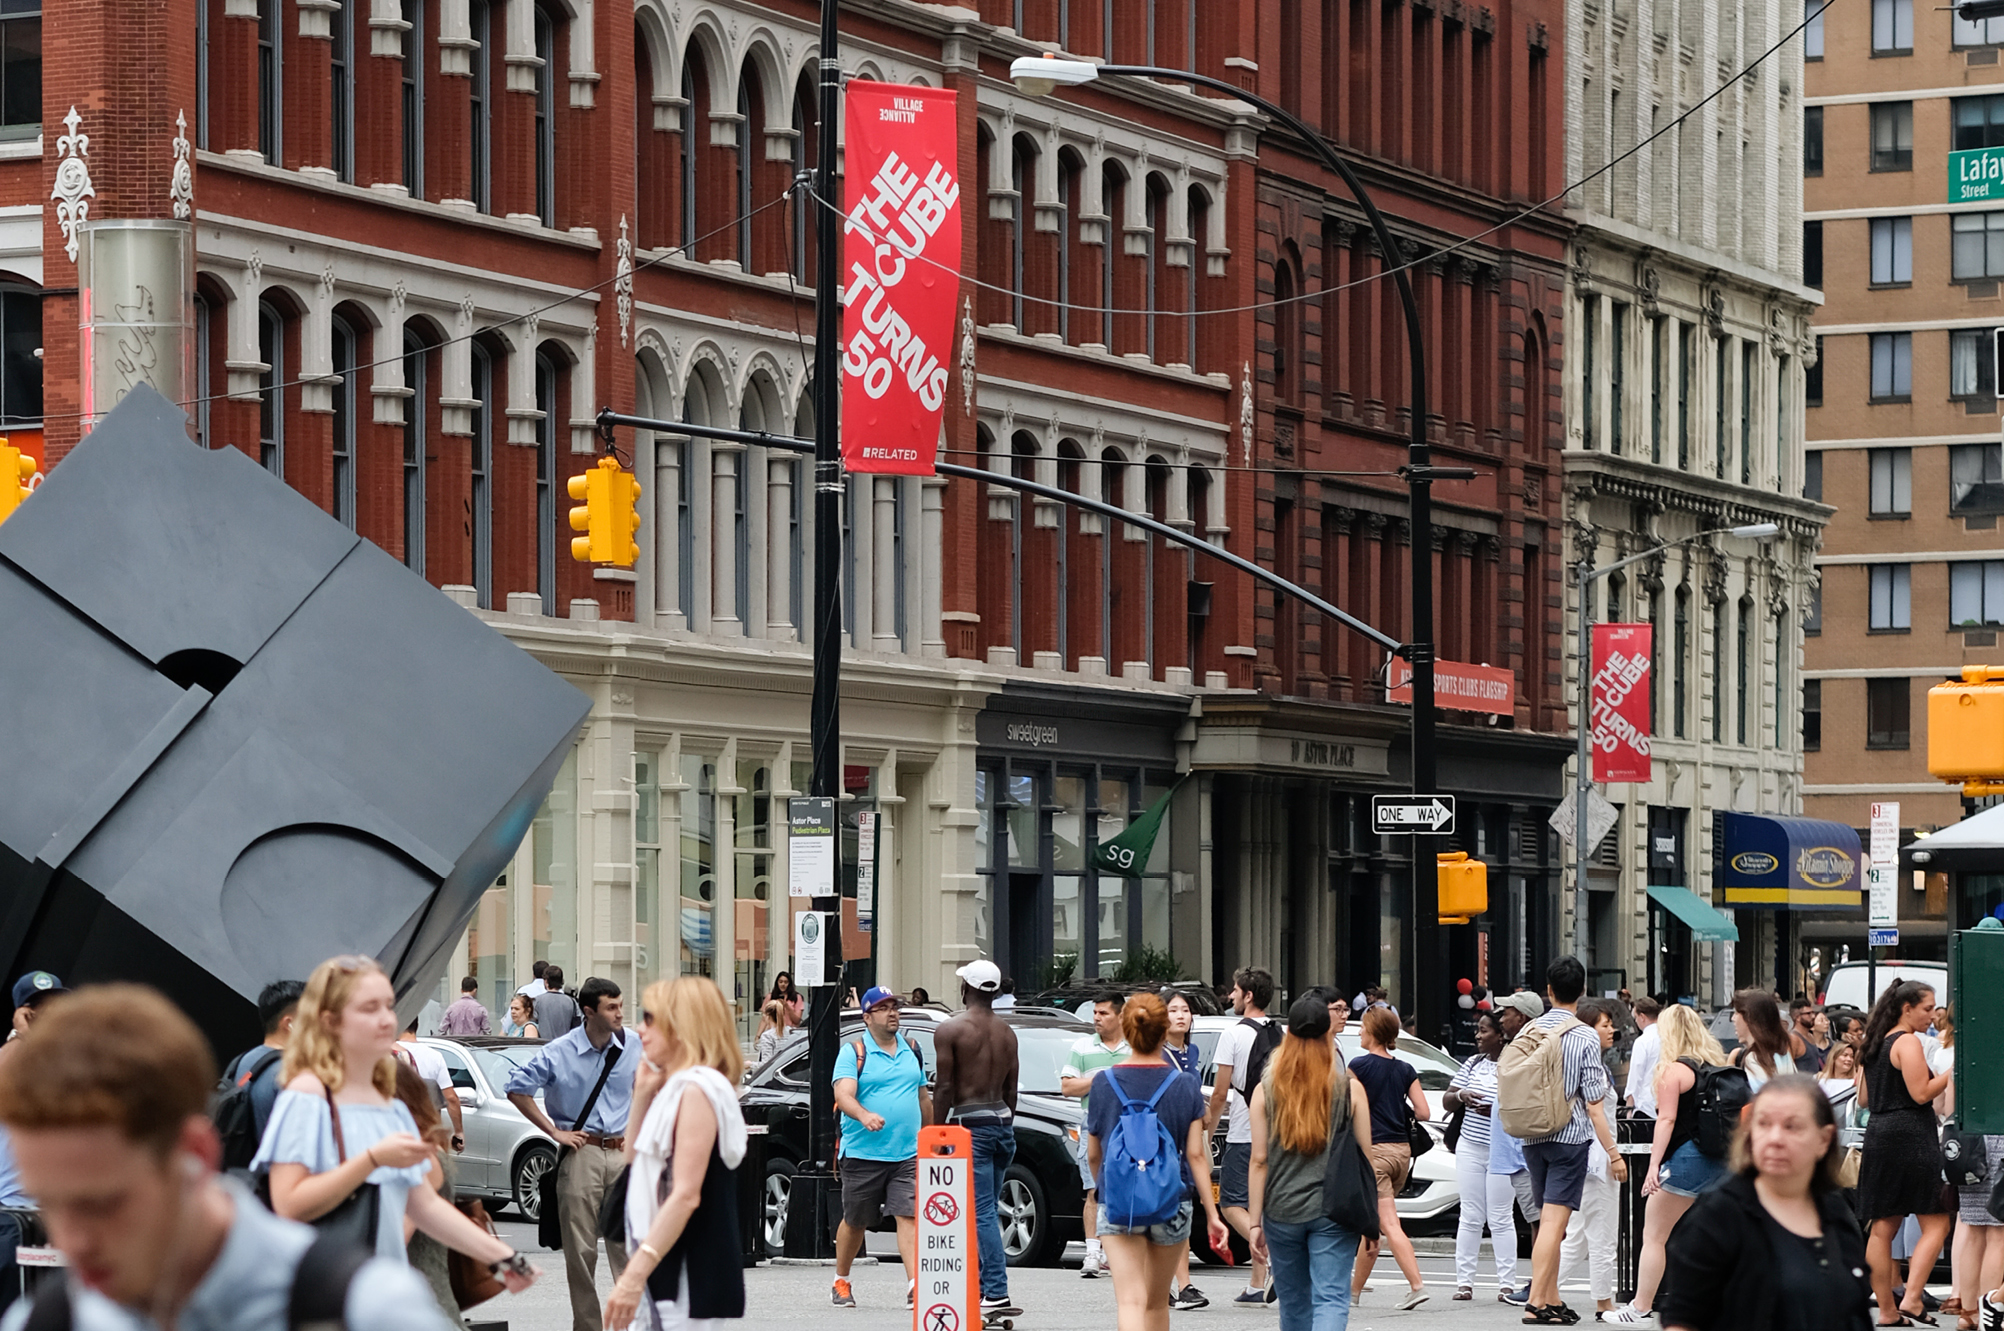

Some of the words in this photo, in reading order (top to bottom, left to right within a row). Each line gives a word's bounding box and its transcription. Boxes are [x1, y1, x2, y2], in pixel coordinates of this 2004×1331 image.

[879, 108, 916, 124] ALLIANCE
[893, 98, 924, 113] VILLAGE
[844, 150, 919, 247] THE
[1960, 183, 1990, 199] Street
[874, 160, 960, 288] CUBE
[843, 261, 948, 413] TURNS
[843, 329, 893, 400] 50
[870, 447, 918, 461] RELATED
[1592, 650, 1629, 692] THE
[1605, 652, 1651, 707] CUBE
[1434, 673, 1458, 695] SPORTS
[1458, 677, 1479, 698] CLUBS
[1479, 680, 1508, 701] FLAGSHIP
[1006, 721, 1058, 747] sweetgreen
[1592, 697, 1651, 757] TURNS
[1592, 724, 1618, 754] 50
[1303, 741, 1328, 765] ASTOR
[1329, 744, 1355, 768] PLACE
[791, 816, 807, 825] Astor
[807, 816, 822, 825] Place
[1380, 807, 1404, 822] ONE
[1417, 807, 1443, 822] WAY
[791, 826, 818, 834] Pedestrian
[818, 826, 831, 834] Plaza
[1106, 844, 1135, 869] sg
[1801, 848, 1829, 875] Vitamin
[1828, 853, 1856, 880] Shoppe
[929, 1165, 954, 1186] NO
[927, 1235, 956, 1249] BIKE
[921, 1258, 962, 1273] RIDING
[933, 1281, 950, 1295] OR
